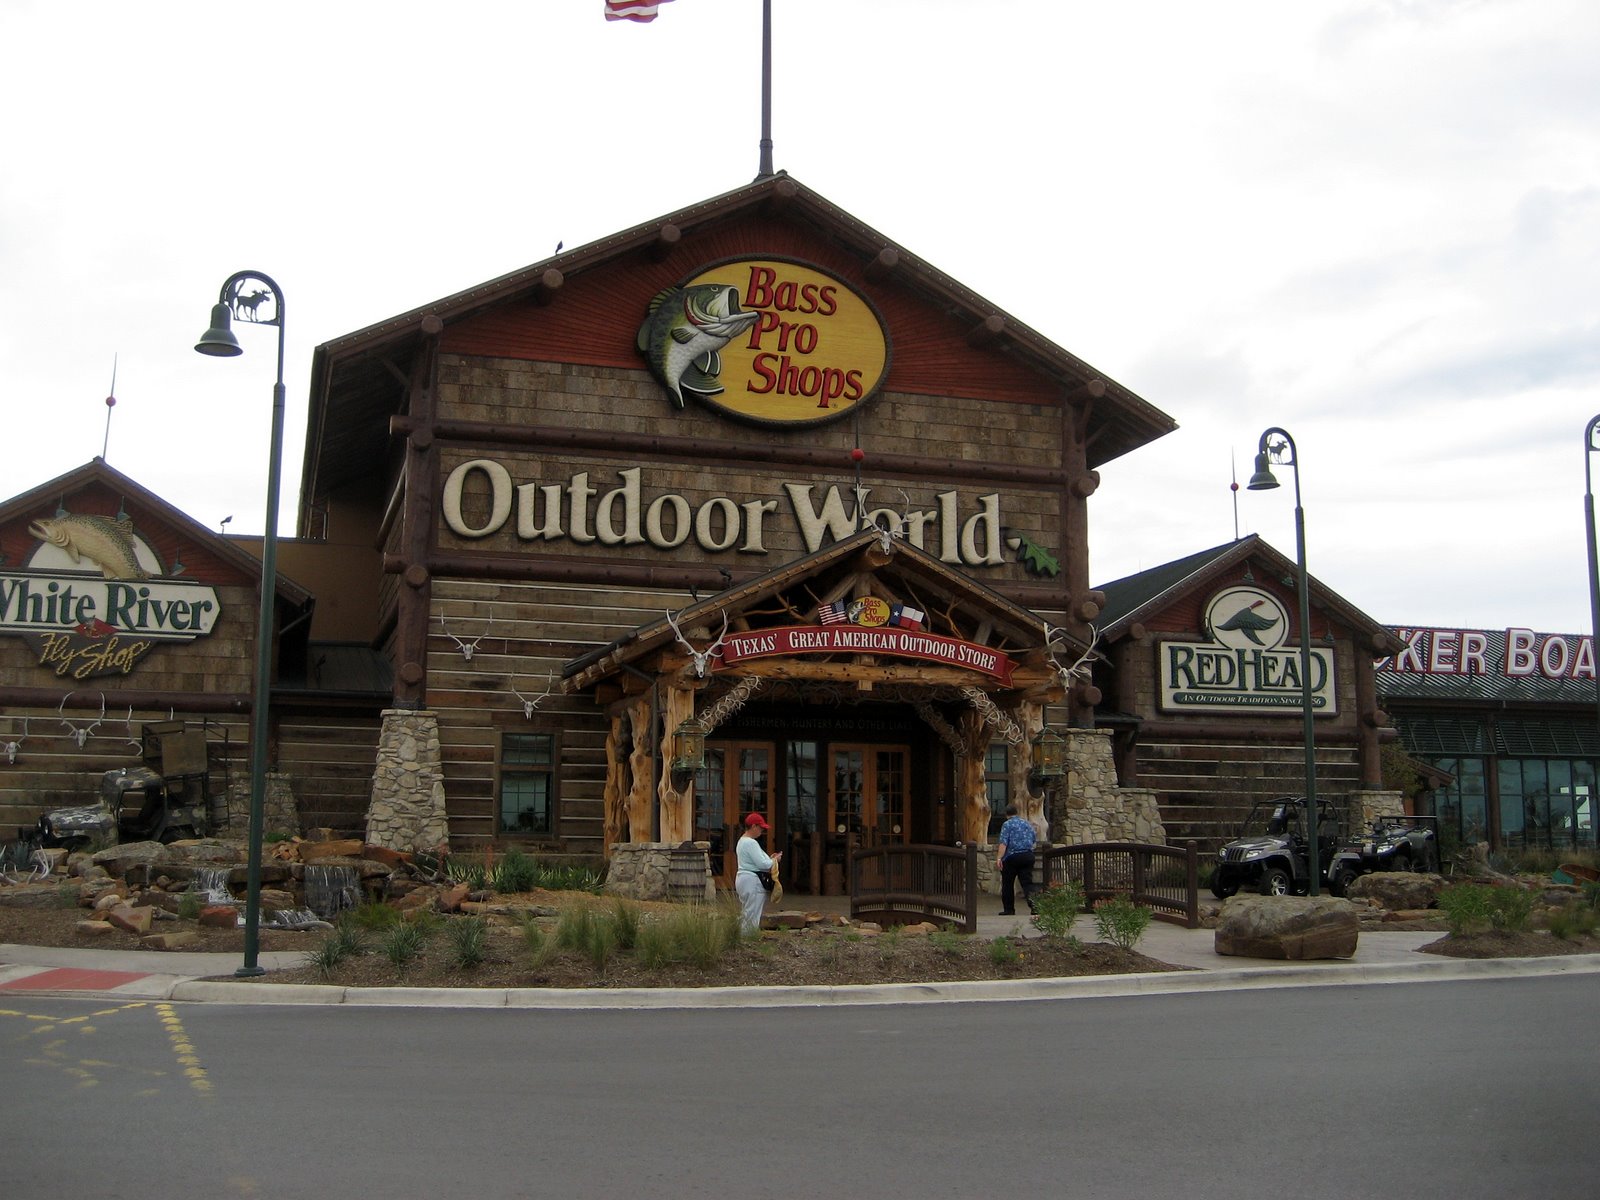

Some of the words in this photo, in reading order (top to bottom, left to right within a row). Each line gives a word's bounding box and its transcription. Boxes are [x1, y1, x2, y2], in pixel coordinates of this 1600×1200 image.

[741, 265, 837, 315] Bass
[746, 311, 818, 354] Pro
[747, 352, 863, 408] Shops
[442, 458, 778, 554] Outdoor
[784, 482, 1005, 566] World
[105, 583, 213, 631] River
[864, 597, 881, 608] Bass
[864, 613, 886, 625] Shops
[39, 632, 76, 676] Fly
[74, 636, 151, 679] Shop
[731, 633, 778, 657] TEXAS'
[789, 631, 830, 649] GREAT
[833, 629, 897, 650] AMERICAN
[900, 633, 956, 660] OUTDOOR
[958, 644, 998, 671] STORE
[1373, 627, 1488, 675] KER
[1195, 694, 1236, 704] OUTDOOR
[1236, 695, 1279, 705] TRADITION
[834, 719, 855, 730] AND
